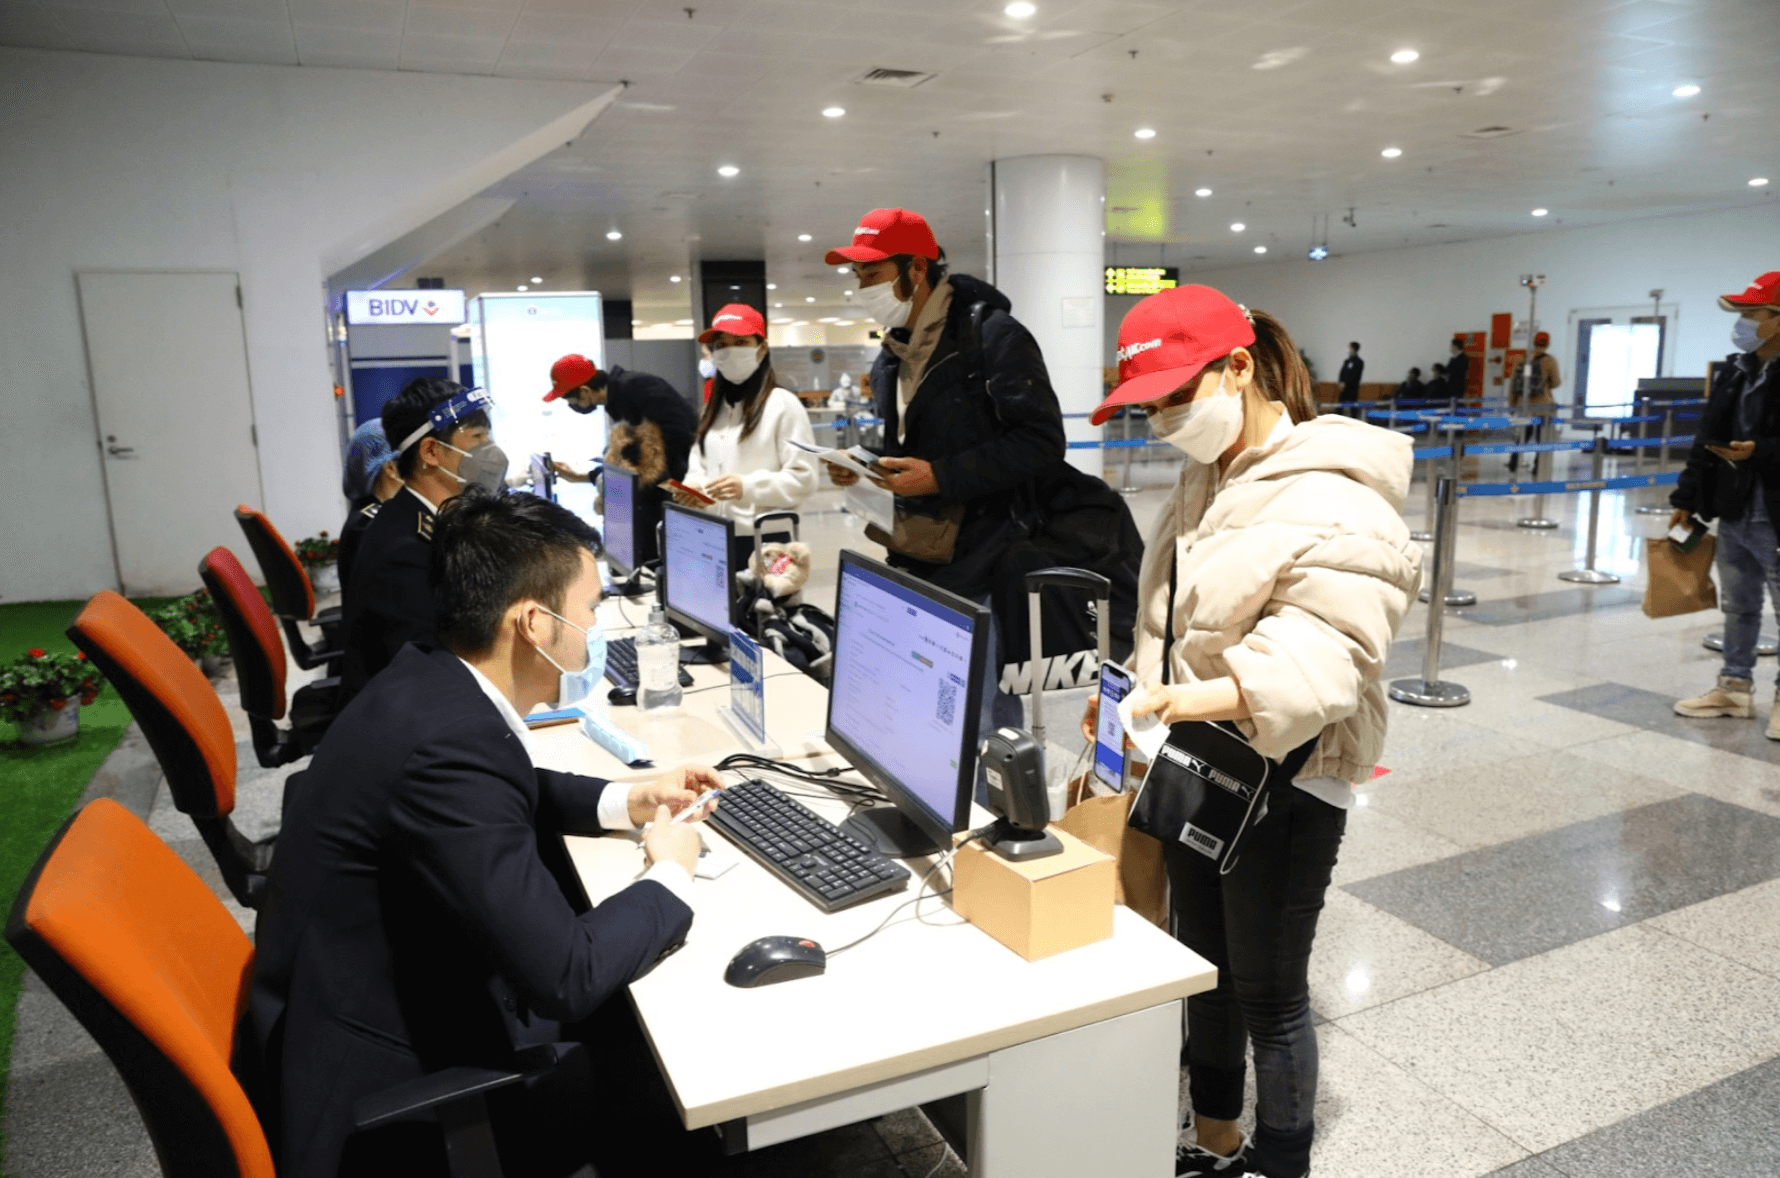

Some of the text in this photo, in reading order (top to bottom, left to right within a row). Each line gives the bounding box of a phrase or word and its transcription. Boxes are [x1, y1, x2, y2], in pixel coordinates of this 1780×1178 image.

[369, 299, 419, 316] BIDV
[1161, 744, 1241, 793] PUMA PUMA
[1187, 827, 1219, 852] PUMA
